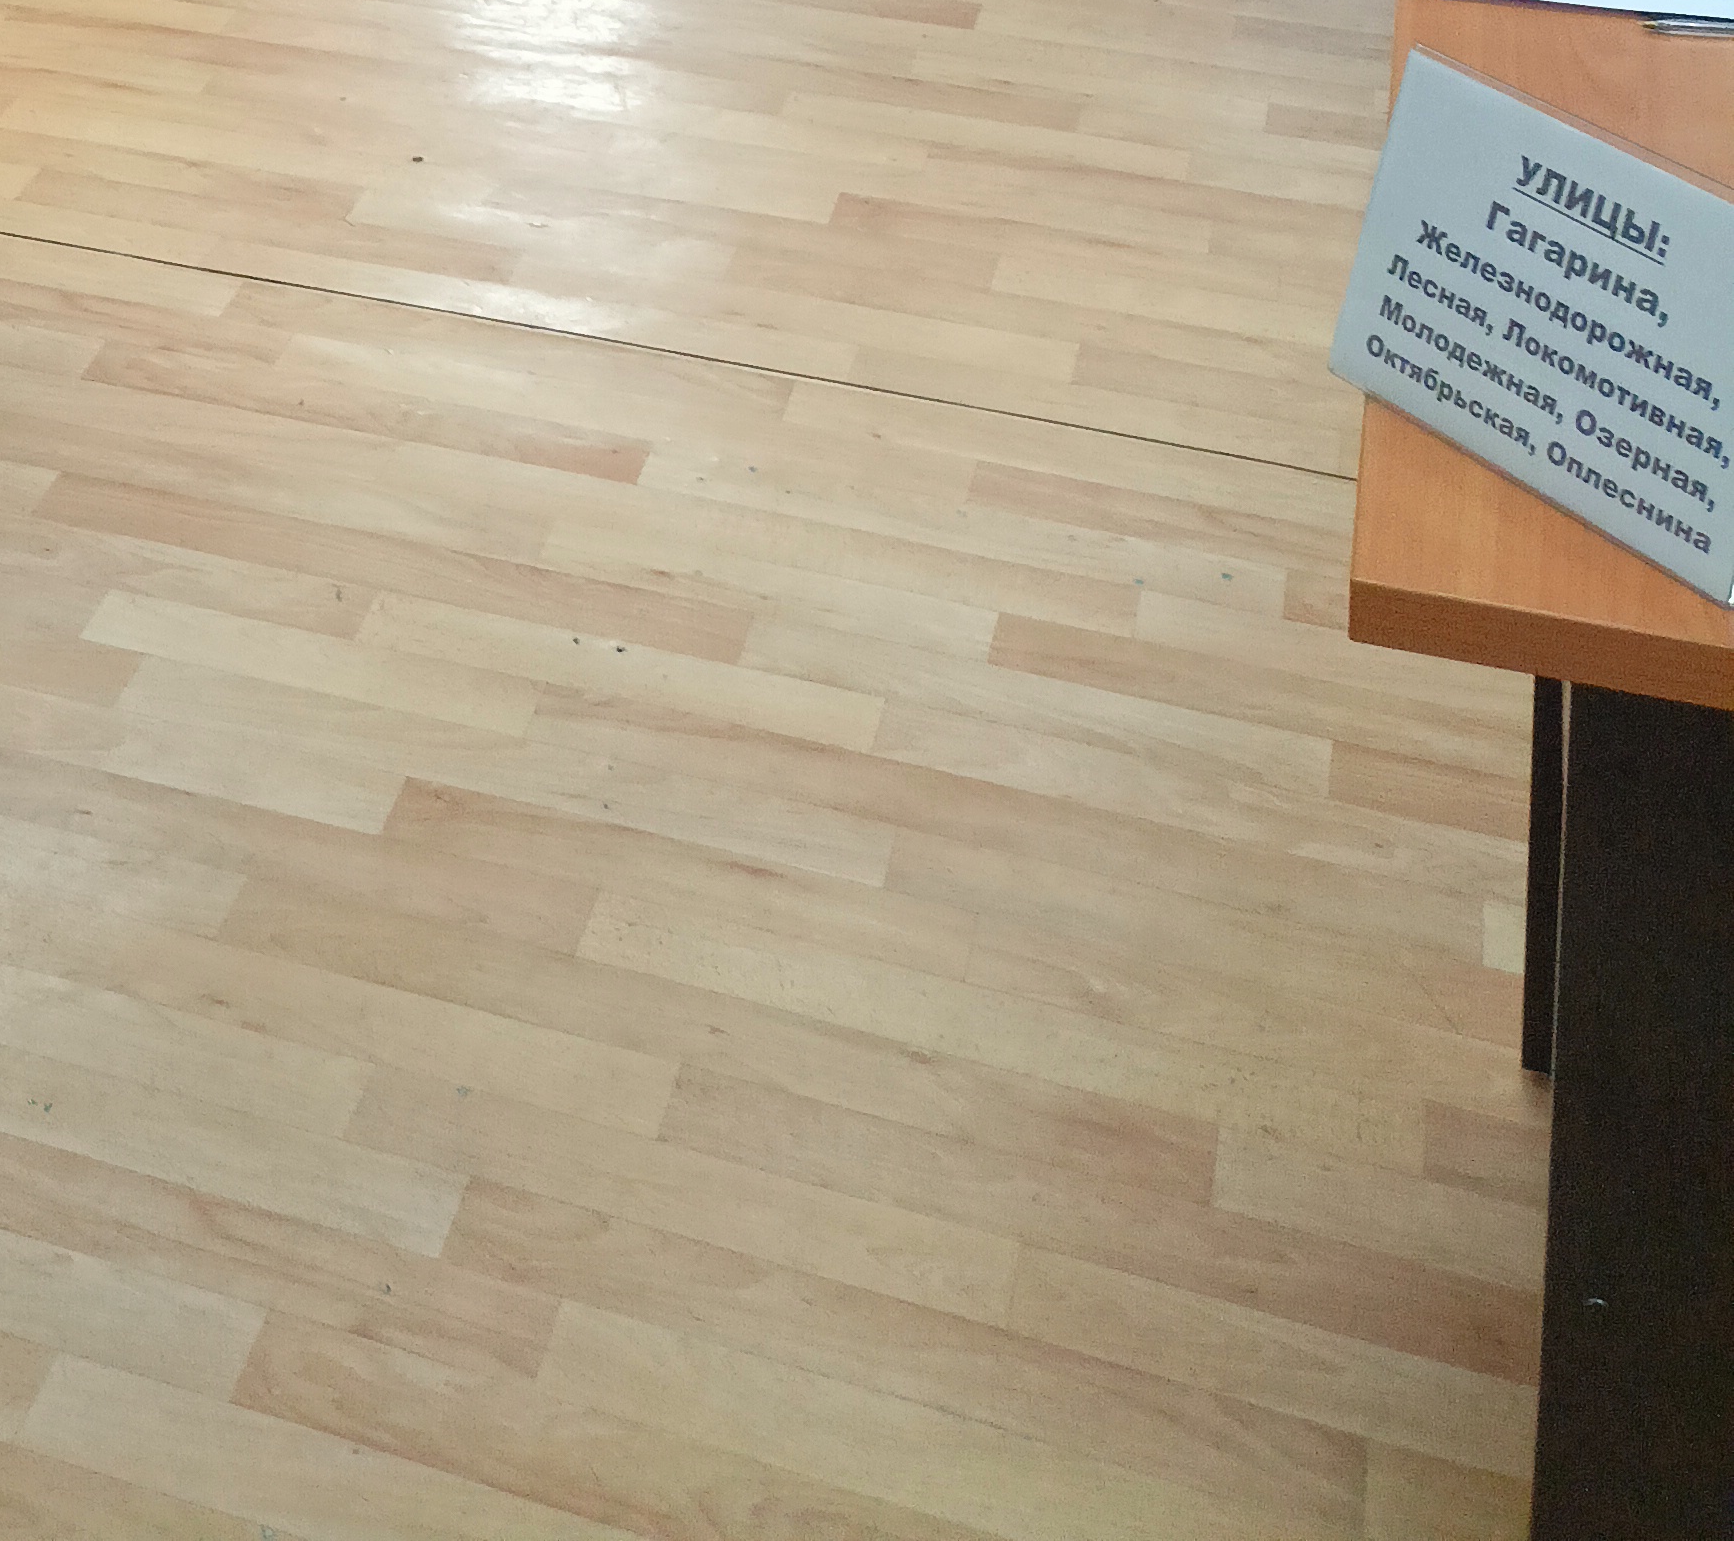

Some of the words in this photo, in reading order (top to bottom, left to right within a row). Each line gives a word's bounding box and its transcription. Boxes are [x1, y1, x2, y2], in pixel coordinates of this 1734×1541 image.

[1486, 200, 1669, 328] Гагарина,
[1516, 154, 1670, 258] УЛИЦЫ:
[1378, 294, 1563, 425] Молодежная,
[1575, 409, 1715, 512] Озерная,
[1387, 253, 1494, 336] Лесная,
[1502, 318, 1730, 469] Локомотивная,
[1417, 219, 1721, 411] Железнодорожная,
[1366, 334, 1536, 457] Октябрьская,
[1546, 440, 1712, 554] Оплеснина
